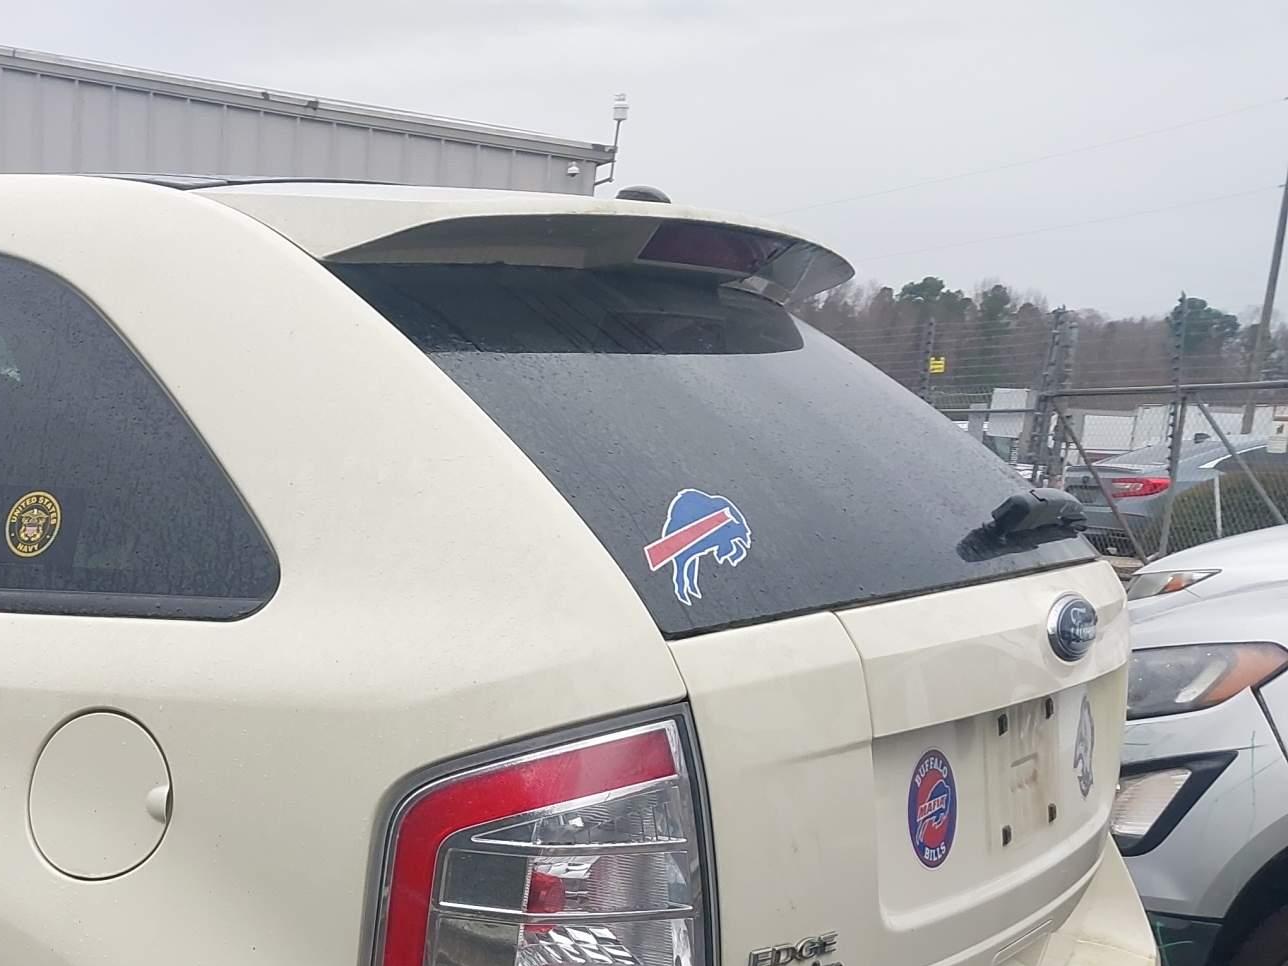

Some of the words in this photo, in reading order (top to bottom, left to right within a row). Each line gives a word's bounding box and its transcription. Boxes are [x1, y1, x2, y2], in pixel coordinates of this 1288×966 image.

[11, 496, 37, 523] UNITED
[38, 496, 57, 525] STATES
[16, 542, 39, 553] NAVY
[923, 842, 946, 862] BILLS
